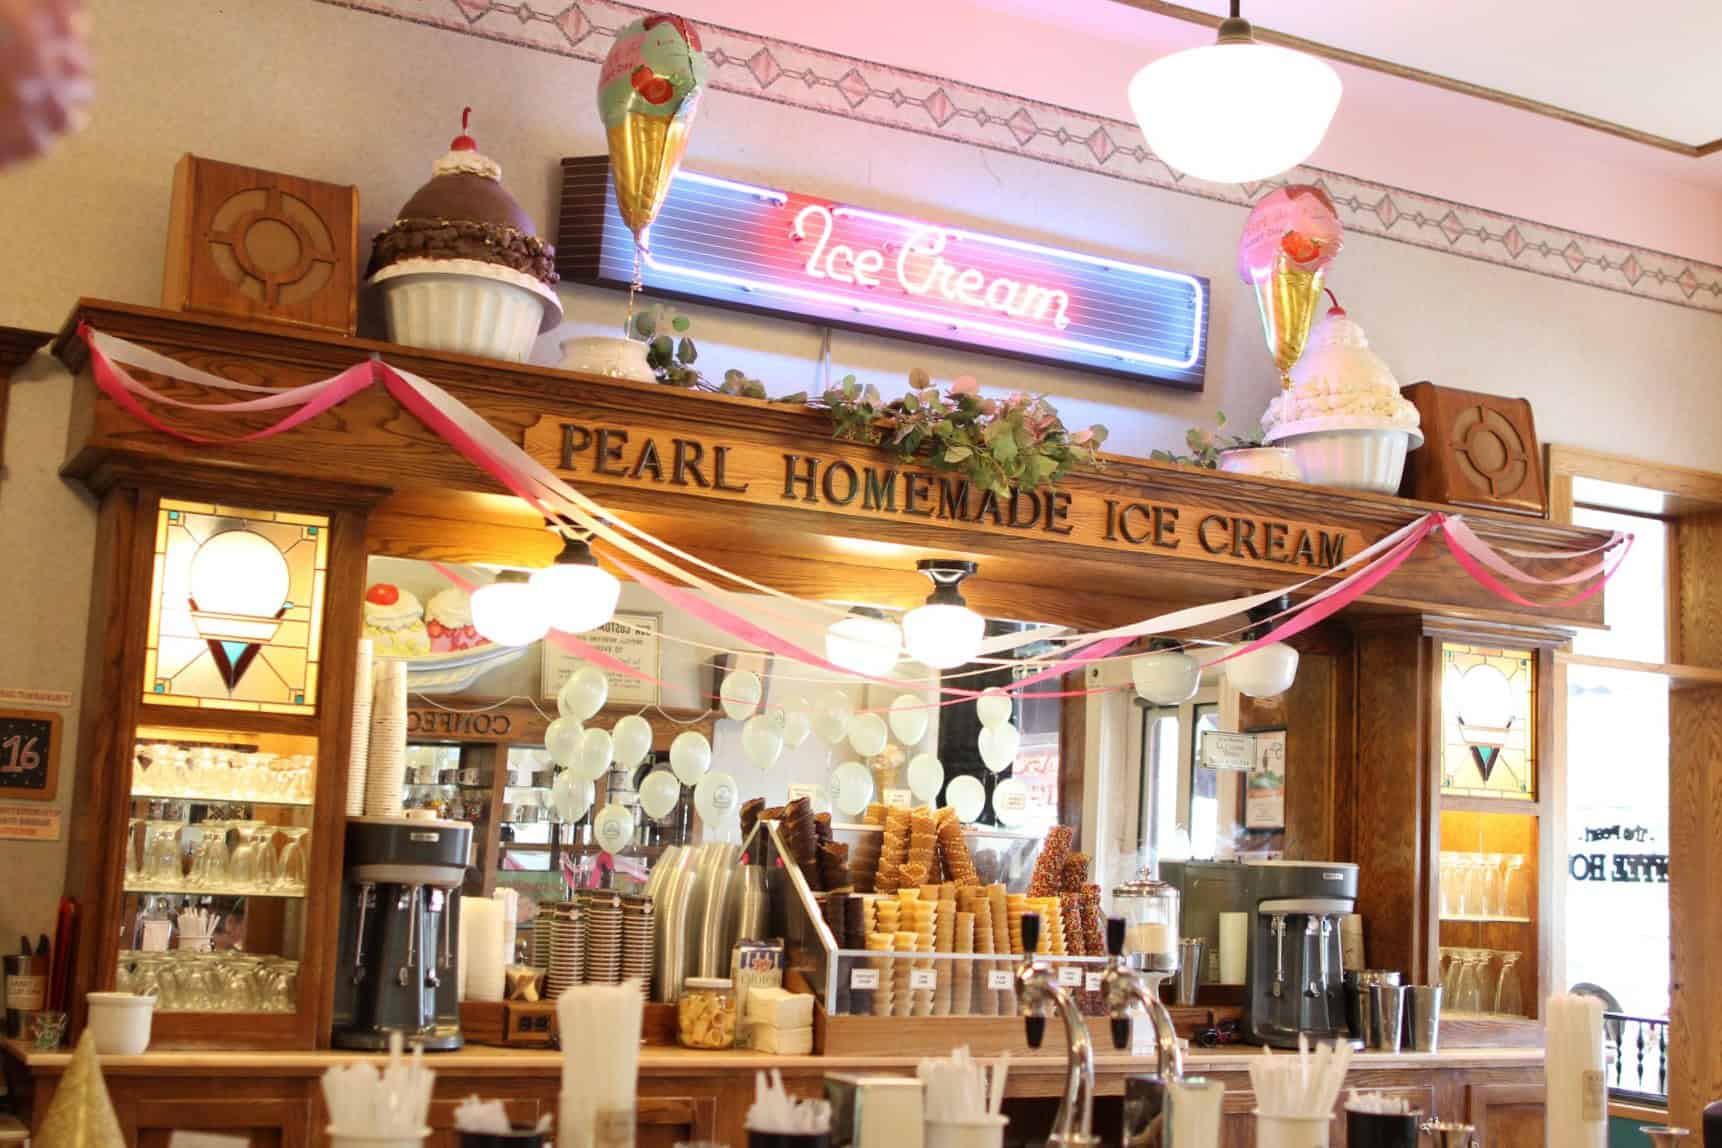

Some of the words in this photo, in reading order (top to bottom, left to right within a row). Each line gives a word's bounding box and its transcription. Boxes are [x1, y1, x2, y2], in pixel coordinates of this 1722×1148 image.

[790, 204, 885, 286] Ice
[896, 229, 1071, 330] Cream
[556, 422, 749, 493] PEARL
[780, 453, 1075, 535] HOMEMADE
[1101, 499, 1181, 549] ICE
[1198, 513, 1347, 571] CREAM
